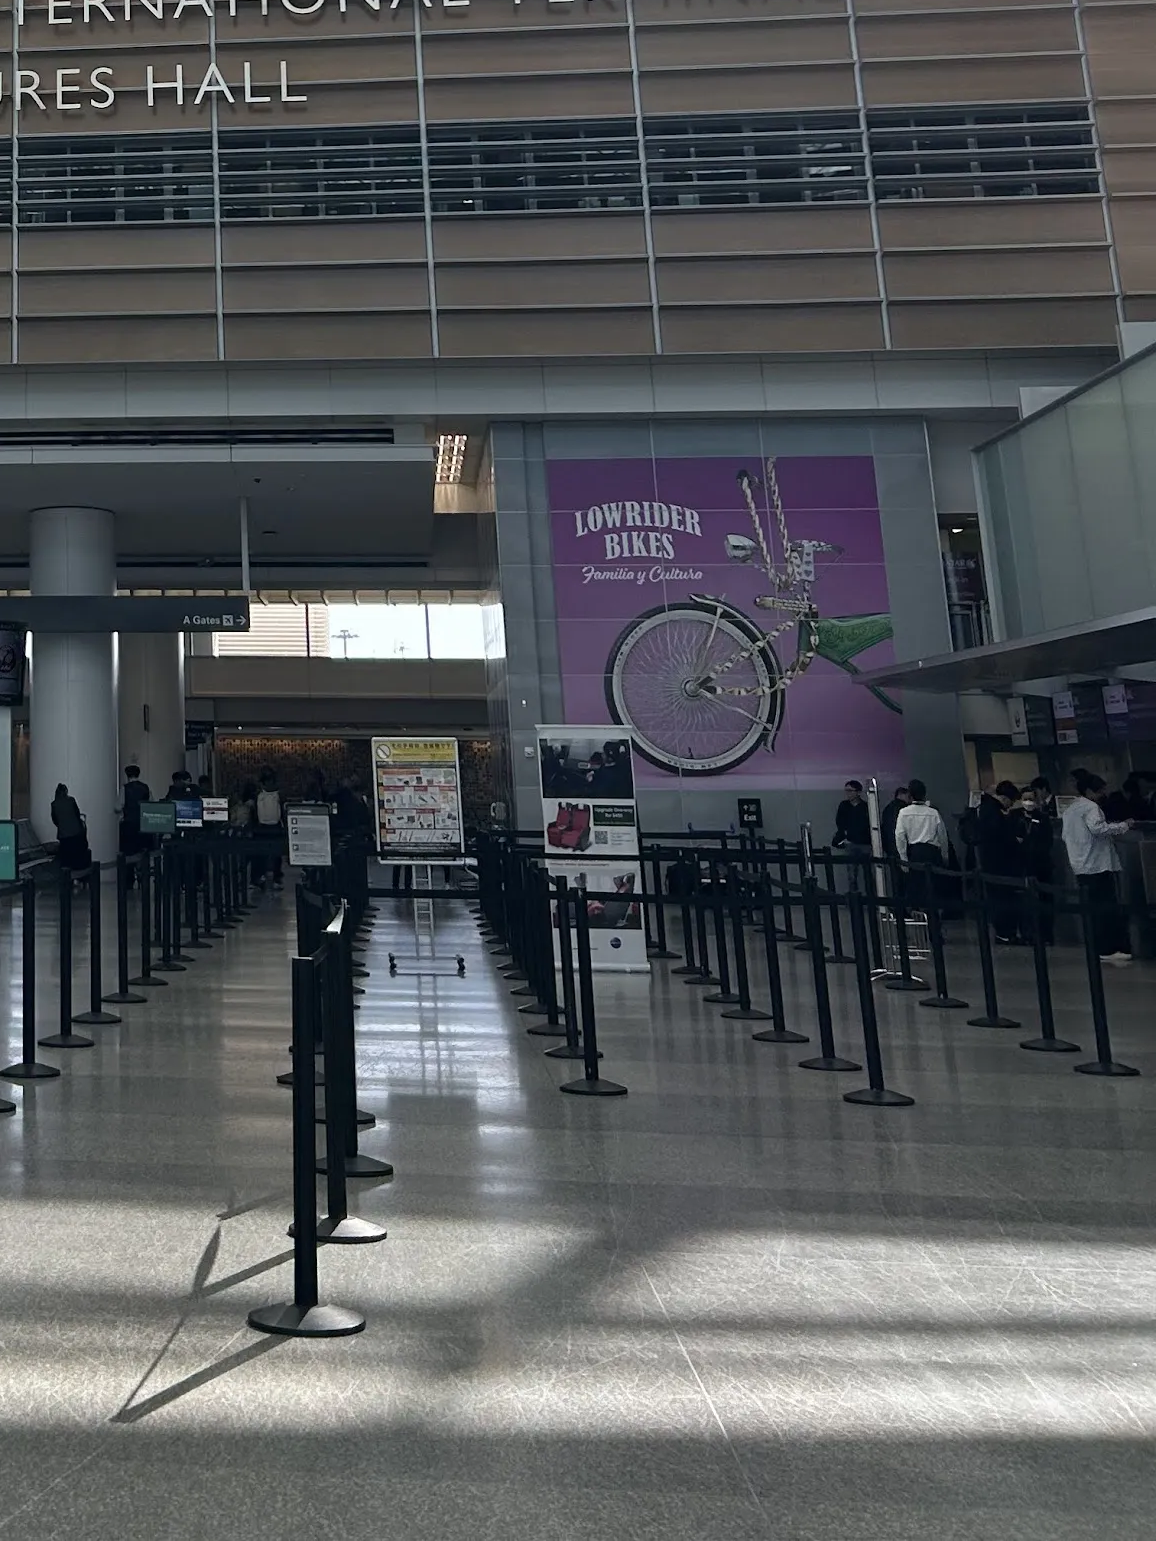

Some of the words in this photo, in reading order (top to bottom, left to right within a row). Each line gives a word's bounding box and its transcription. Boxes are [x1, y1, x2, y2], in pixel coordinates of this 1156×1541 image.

[146, 60, 308, 108] HALL
[575, 501, 702, 537] LOWRIDER
[604, 531, 675, 560] BIKES
[582, 566, 635, 584] Familia
[636, 571, 646, 585] y
[649, 565, 703, 583] Cultura
[183, 615, 191, 625] A
[192, 615, 221, 625] Gates
